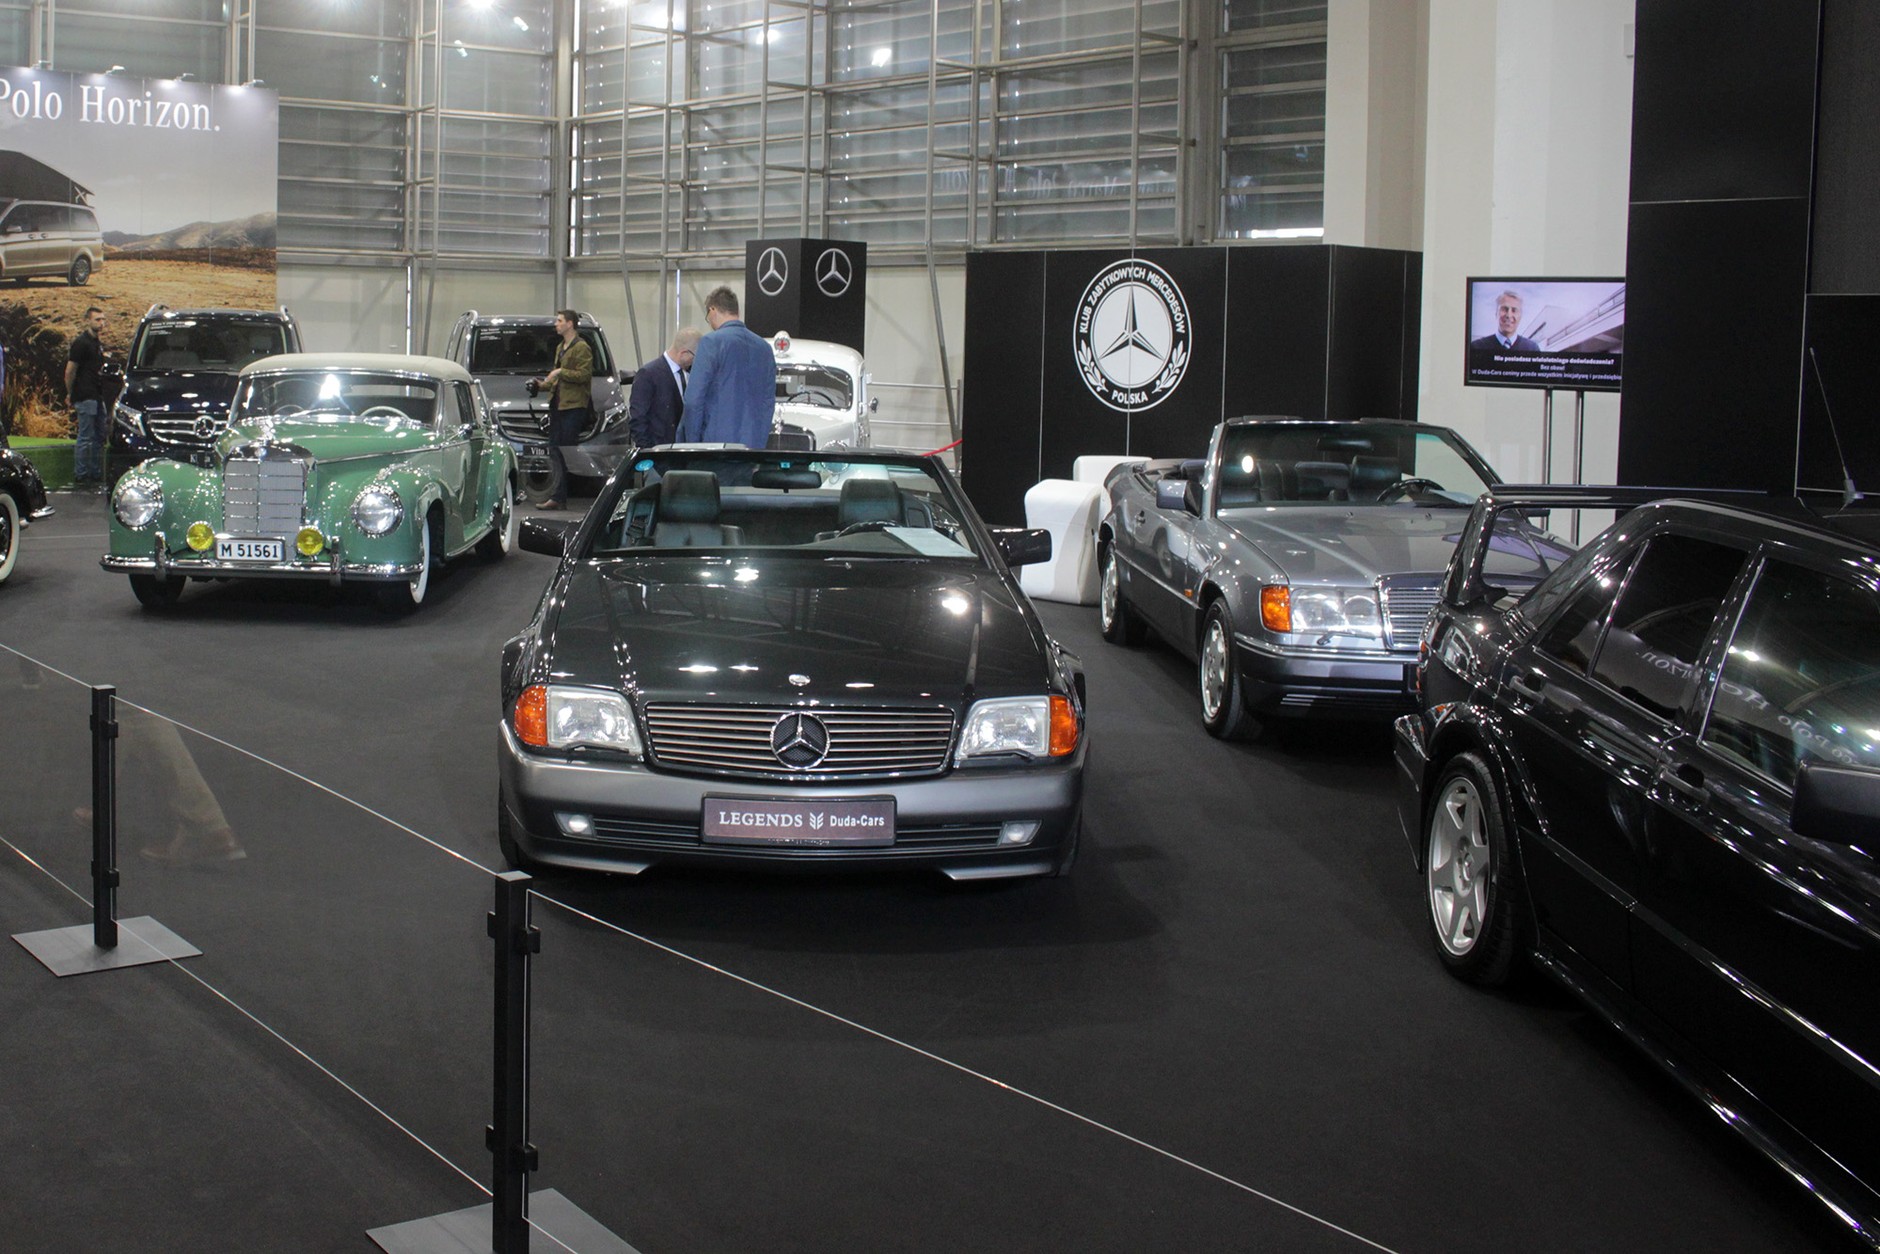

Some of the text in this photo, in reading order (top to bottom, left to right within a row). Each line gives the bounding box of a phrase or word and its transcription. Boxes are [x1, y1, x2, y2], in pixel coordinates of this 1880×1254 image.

[79, 84, 221, 132] Horizon.
[1079, 266, 1186, 334] KLUB ZABYTKOWYCH MERCEDESÓW
[1111, 389, 1149, 405] POLSKA
[530, 446, 545, 456] Vito
[221, 543, 278, 558] M 51561
[719, 811, 803, 828] LEGENDS
